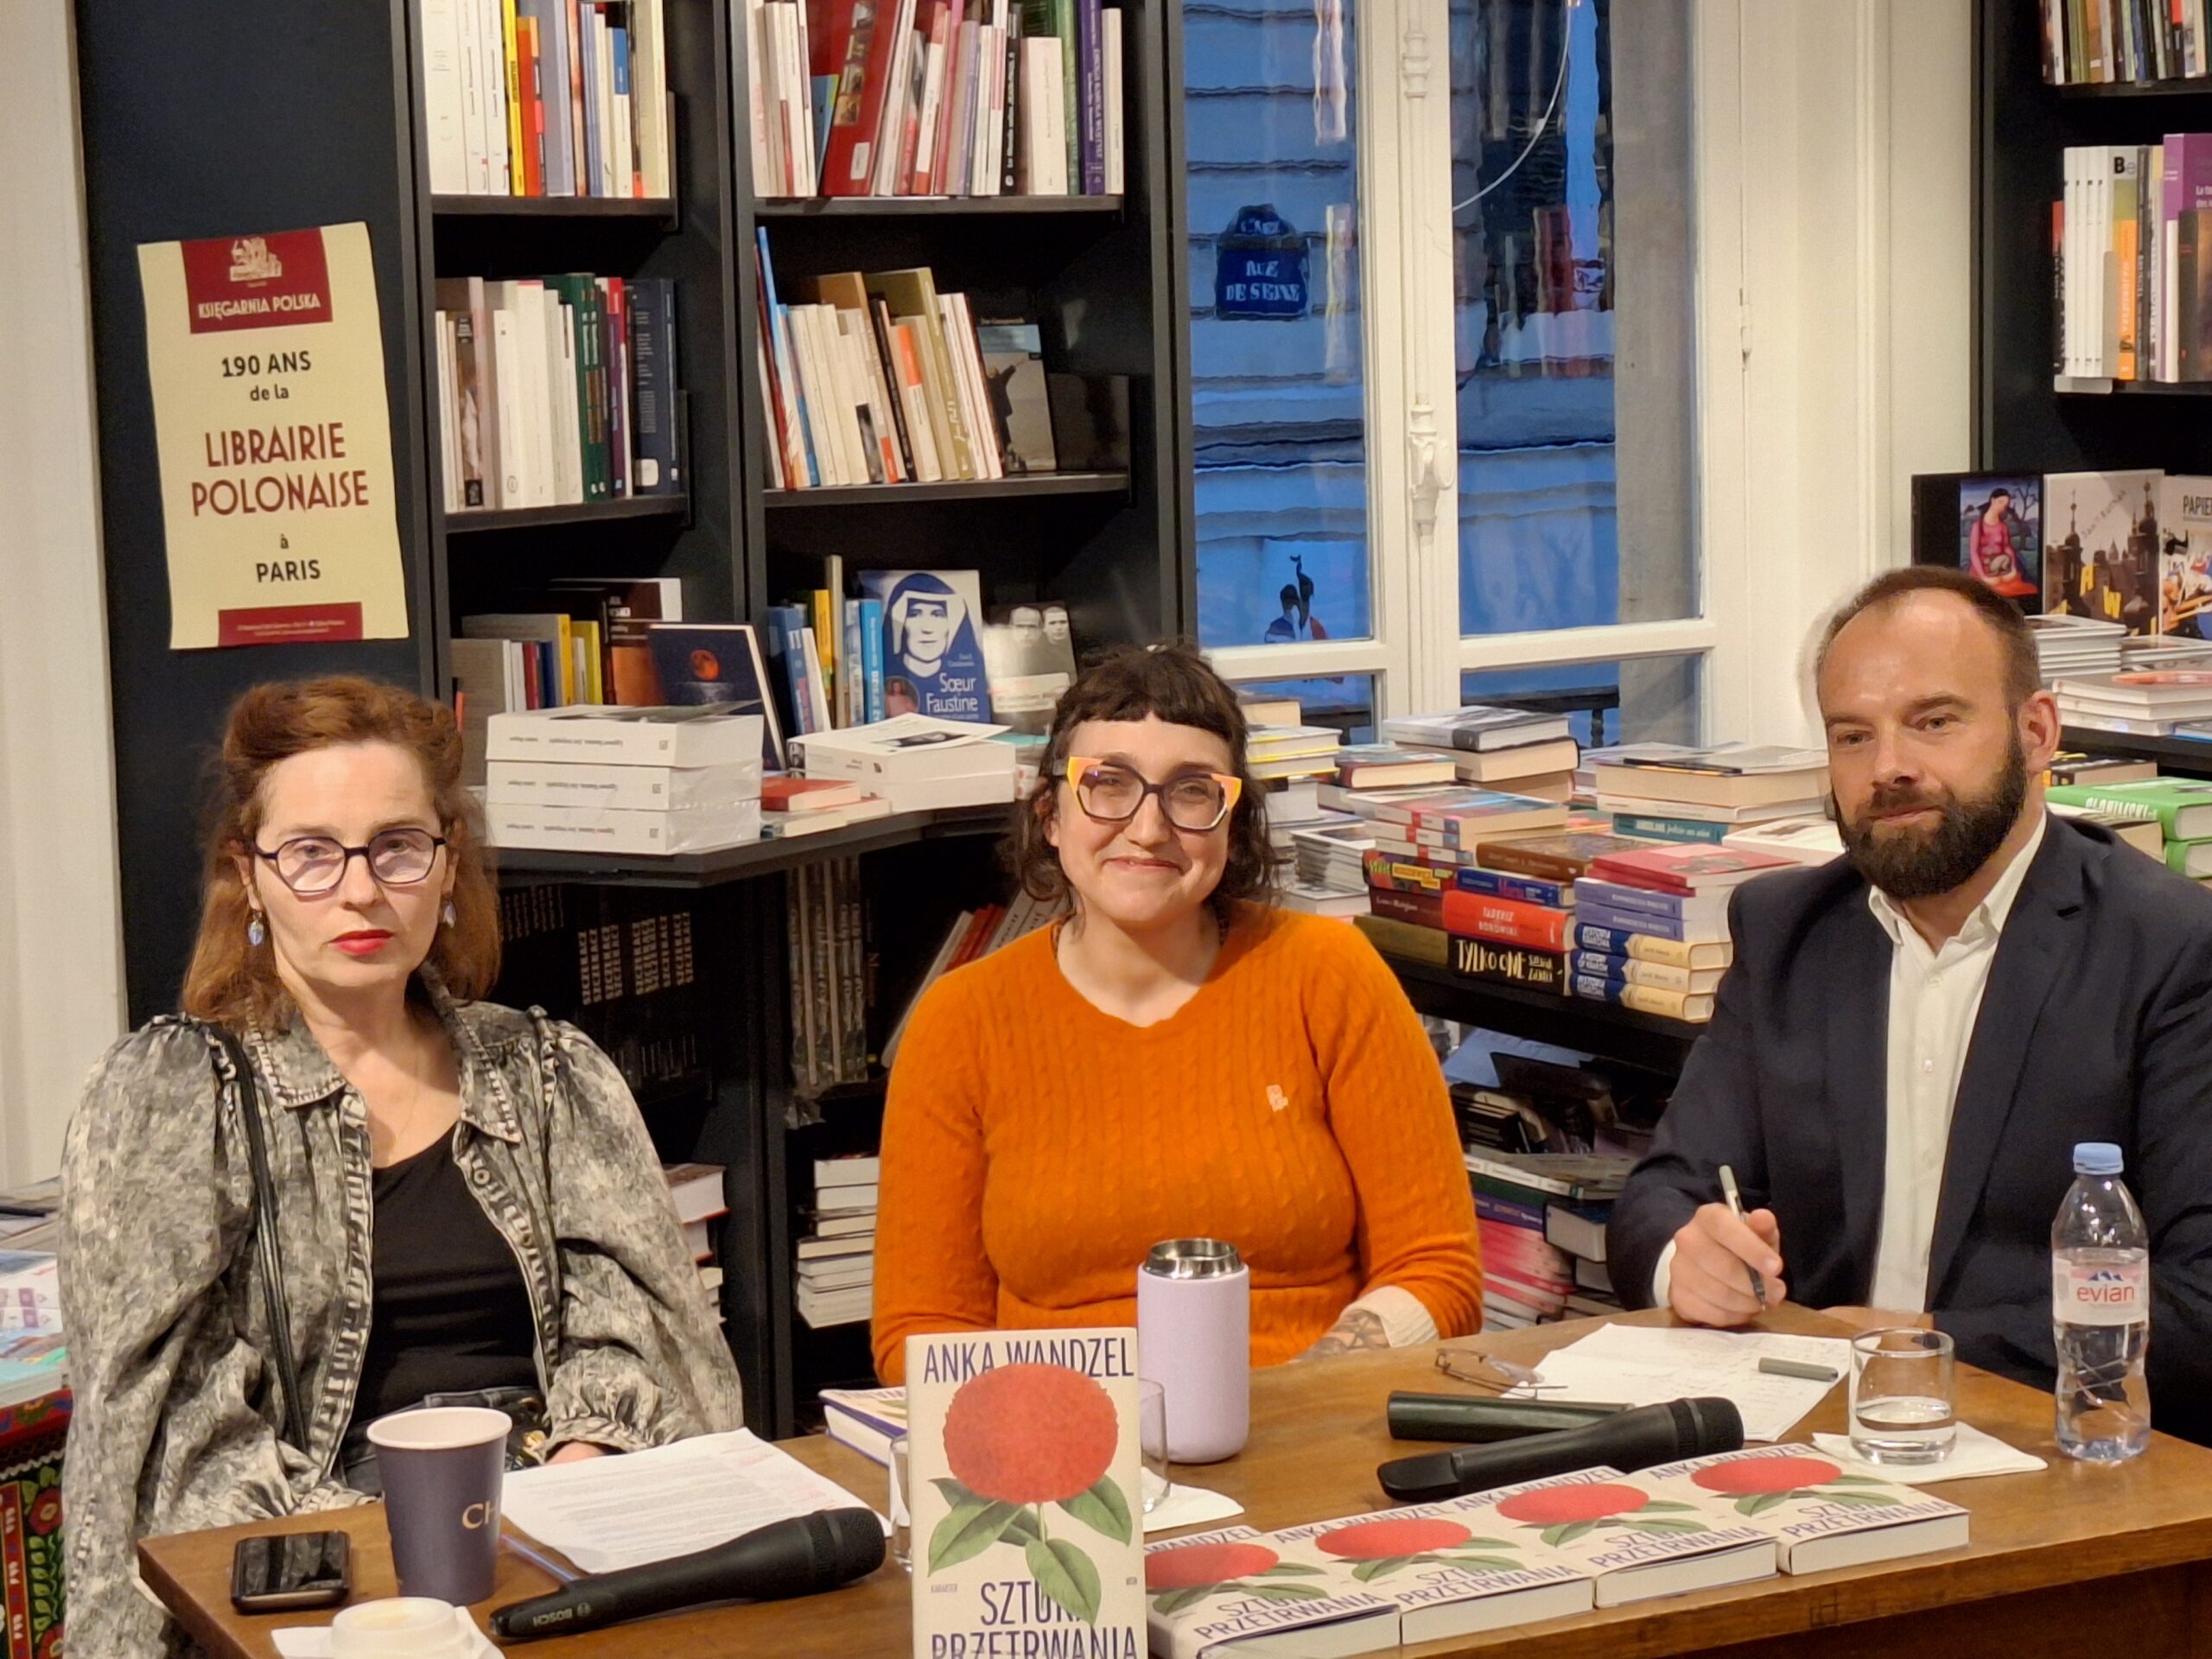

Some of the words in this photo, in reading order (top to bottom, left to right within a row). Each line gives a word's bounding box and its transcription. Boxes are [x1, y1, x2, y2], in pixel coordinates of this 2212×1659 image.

[1246, 260, 1279, 278] RUE
[1226, 283, 1246, 302] DE
[1250, 283, 1300, 302] SEINE
[198, 297, 270, 320] KSIĘGARNIA
[272, 292, 321, 312] POLSKA
[221, 355, 260, 378] 190
[268, 351, 311, 374] ANS
[250, 385, 270, 402] de
[274, 384, 289, 400] la
[205, 421, 346, 467] LIBRAIRIE
[191, 469, 370, 518] POLONAISE
[279, 532, 289, 550] à
[256, 559, 321, 583] PARIS
[939, 672, 976, 693] Sœur
[926, 693, 978, 714] Faustine
[1455, 938, 1497, 973] TYLKO
[2076, 1284, 2135, 1302] evian
[925, 1342, 995, 1383] ANKA
[1006, 1338, 1135, 1378] WANDZEL
[1649, 1460, 1707, 1481] ANKA
[1453, 1491, 1513, 1511] ANKA
[1798, 1503, 1880, 1520] SZTU
[1781, 1500, 1964, 1538] PRZETRWANIA
[1274, 1523, 1335, 1545] ANKA
[1605, 1531, 1685, 1549] SZTU
[1589, 1525, 1767, 1569] PRZETRWANIA
[1395, 1565, 1580, 1605] PRZETRWANIA
[1416, 1566, 1504, 1586] SZTU
[980, 1580, 1082, 1626] SZTU
[1217, 1599, 1306, 1617] SZTU
[532, 1608, 572, 1626] BOSCH
[1194, 1592, 1383, 1639] PRZETRWANIA
[932, 1626, 1138, 1659] PRZETRWANIA
